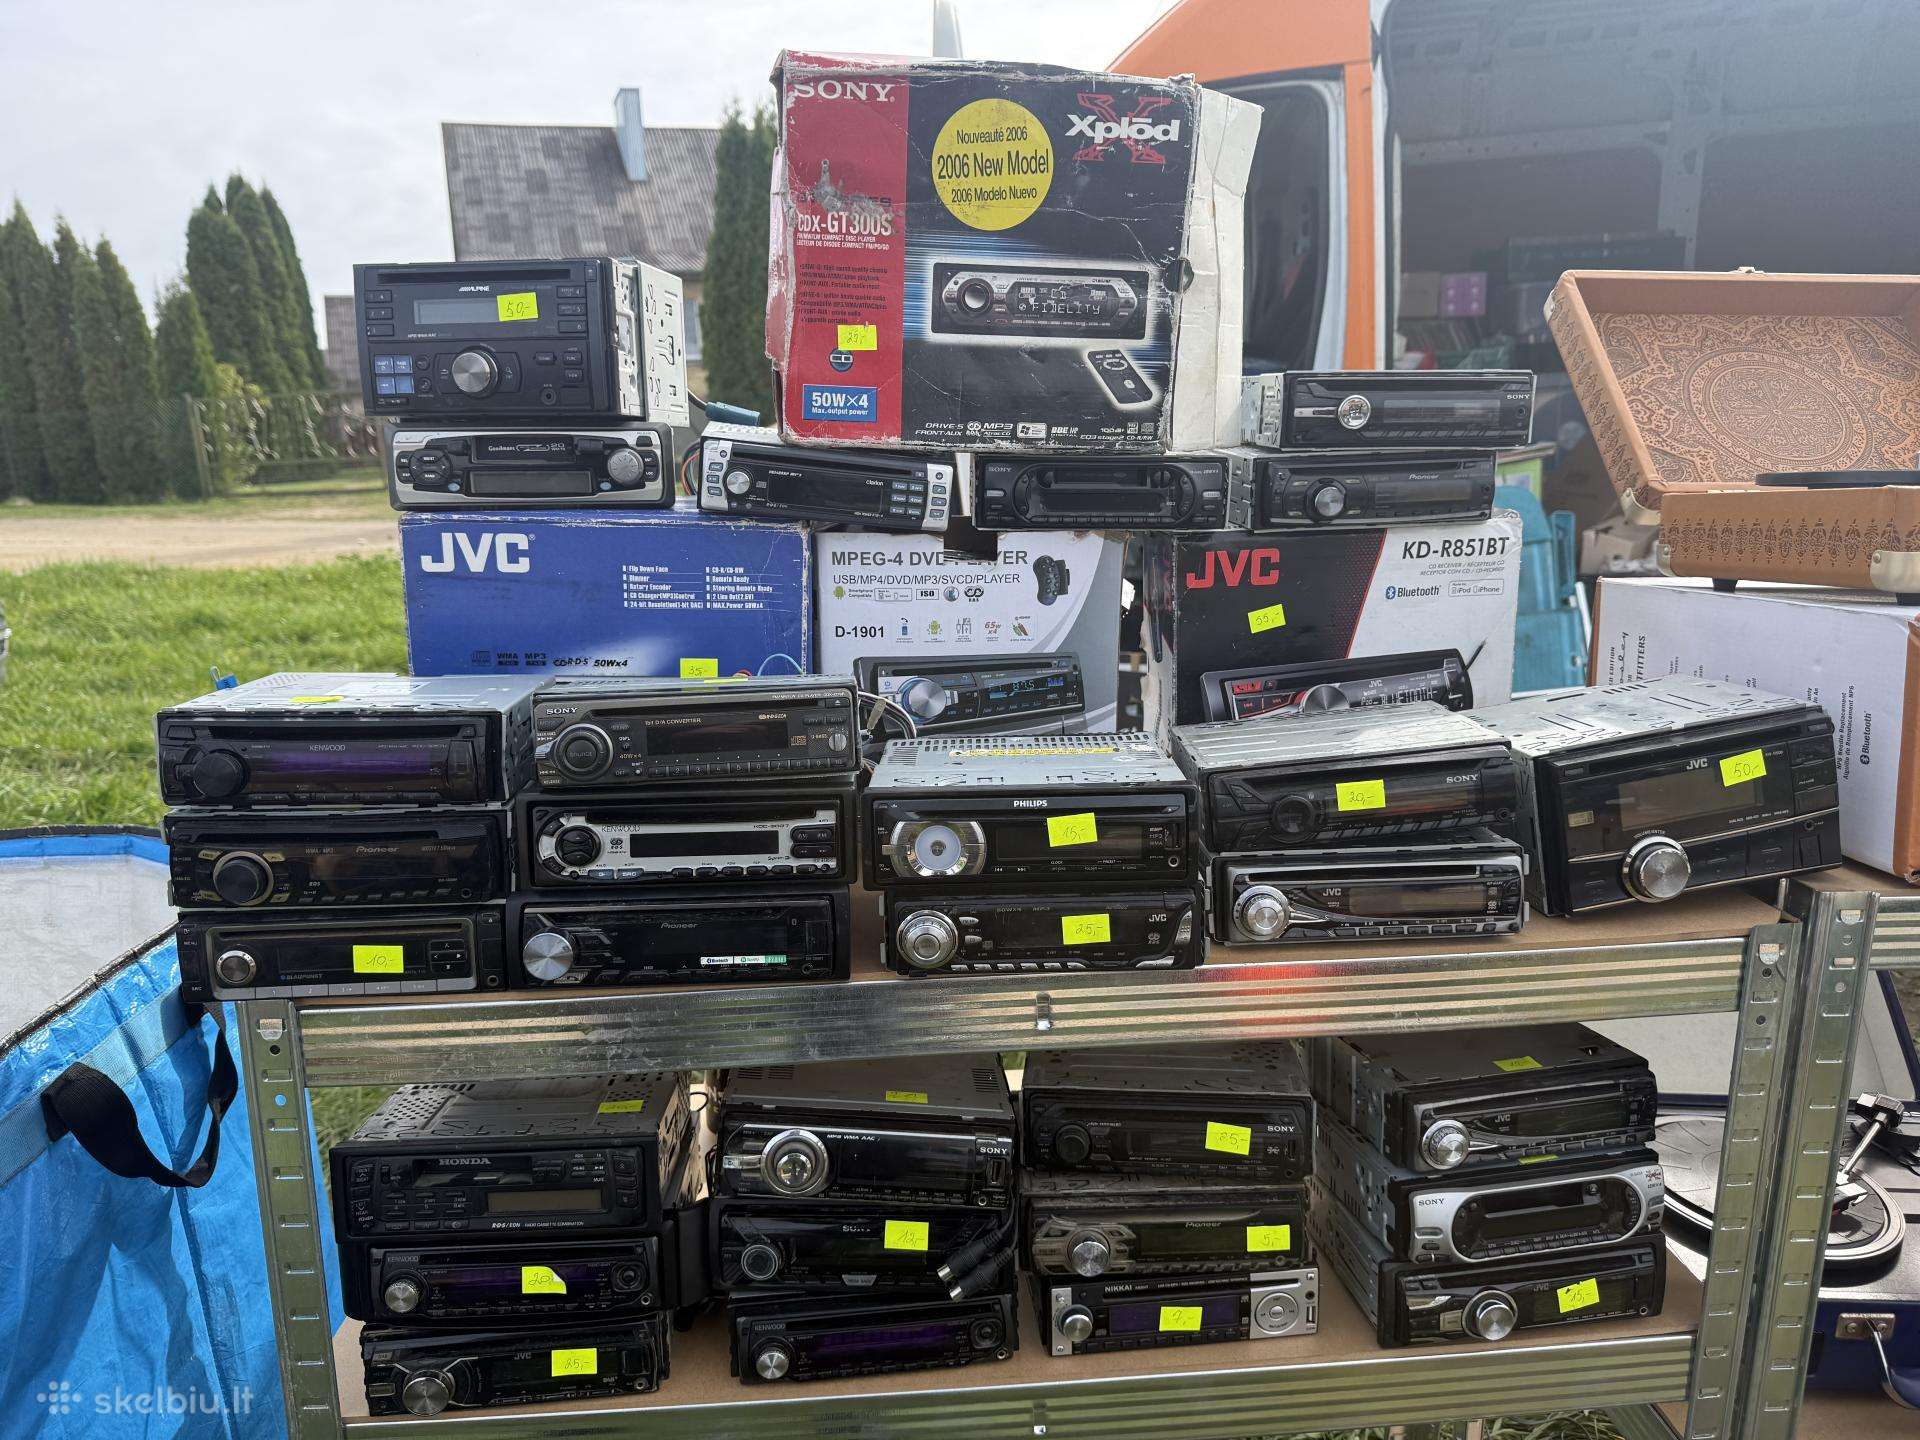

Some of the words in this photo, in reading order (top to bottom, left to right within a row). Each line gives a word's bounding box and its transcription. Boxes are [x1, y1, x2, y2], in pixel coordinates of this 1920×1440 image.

[793, 79, 891, 103] SONY
[956, 126, 1004, 146] Nouveauté
[1005, 126, 1028, 142] 2006
[938, 154, 970, 180] 2006
[973, 152, 1003, 178] New
[1007, 148, 1049, 176] Model
[951, 187, 973, 203] 2006
[974, 186, 1008, 203] Modelo
[1009, 185, 1037, 200] Nuevo
[797, 211, 892, 236] CDX-GT300S
[1032, 303, 1101, 315] FIDELITY
[848, 407, 869, 417] power
[925, 422, 964, 430] DRIVE-S
[983, 421, 1014, 430] MP3
[915, 429, 963, 437] FRONT-AUX
[865, 479, 884, 487] Clarion
[1402, 536, 1510, 559] KD-R851BT
[421, 532, 530, 573] JVC
[831, 551, 904, 566] MPEG-4
[1186, 548, 1280, 589] JVC
[833, 573, 1021, 586] USB/MP4/DVD/MP3/SVCD/PLAYER
[1397, 585, 1440, 598] Bluetooth
[835, 625, 885, 638] D-1901
[546, 707, 578, 715] SONY
[1839, 692, 1847, 734] Replacement
[1845, 698, 1854, 747] Remplacement
[1861, 712, 1871, 754] Bluetooth
[309, 743, 346, 751] KENWOOD
[1686, 758, 1708, 770] JVC
[1446, 774, 1479, 784] SONY
[1013, 799, 1048, 808] PHILIPS
[601, 824, 641, 832] KENWOOD
[356, 846, 399, 854] Pioneer
[1323, 888, 1342, 897] JVC
[1149, 913, 1167, 922] JVC
[660, 921, 699, 929] Pioneer
[286, 973, 323, 981] BLAUPUNKT
[1494, 1114, 1511, 1123] JVC
[979, 1147, 1007, 1155] SONY
[439, 1157, 492, 1166] HONDA
[1417, 1198, 1445, 1206] SONY
[1185, 1221, 1222, 1229] Pioneer
[387, 1255, 420, 1263] KENWOOD
[1104, 1284, 1133, 1293] NIKKAI
[1533, 1283, 1549, 1292] JVC
[754, 1323, 786, 1332] KENWOOD
[514, 1351, 532, 1360] JVC
